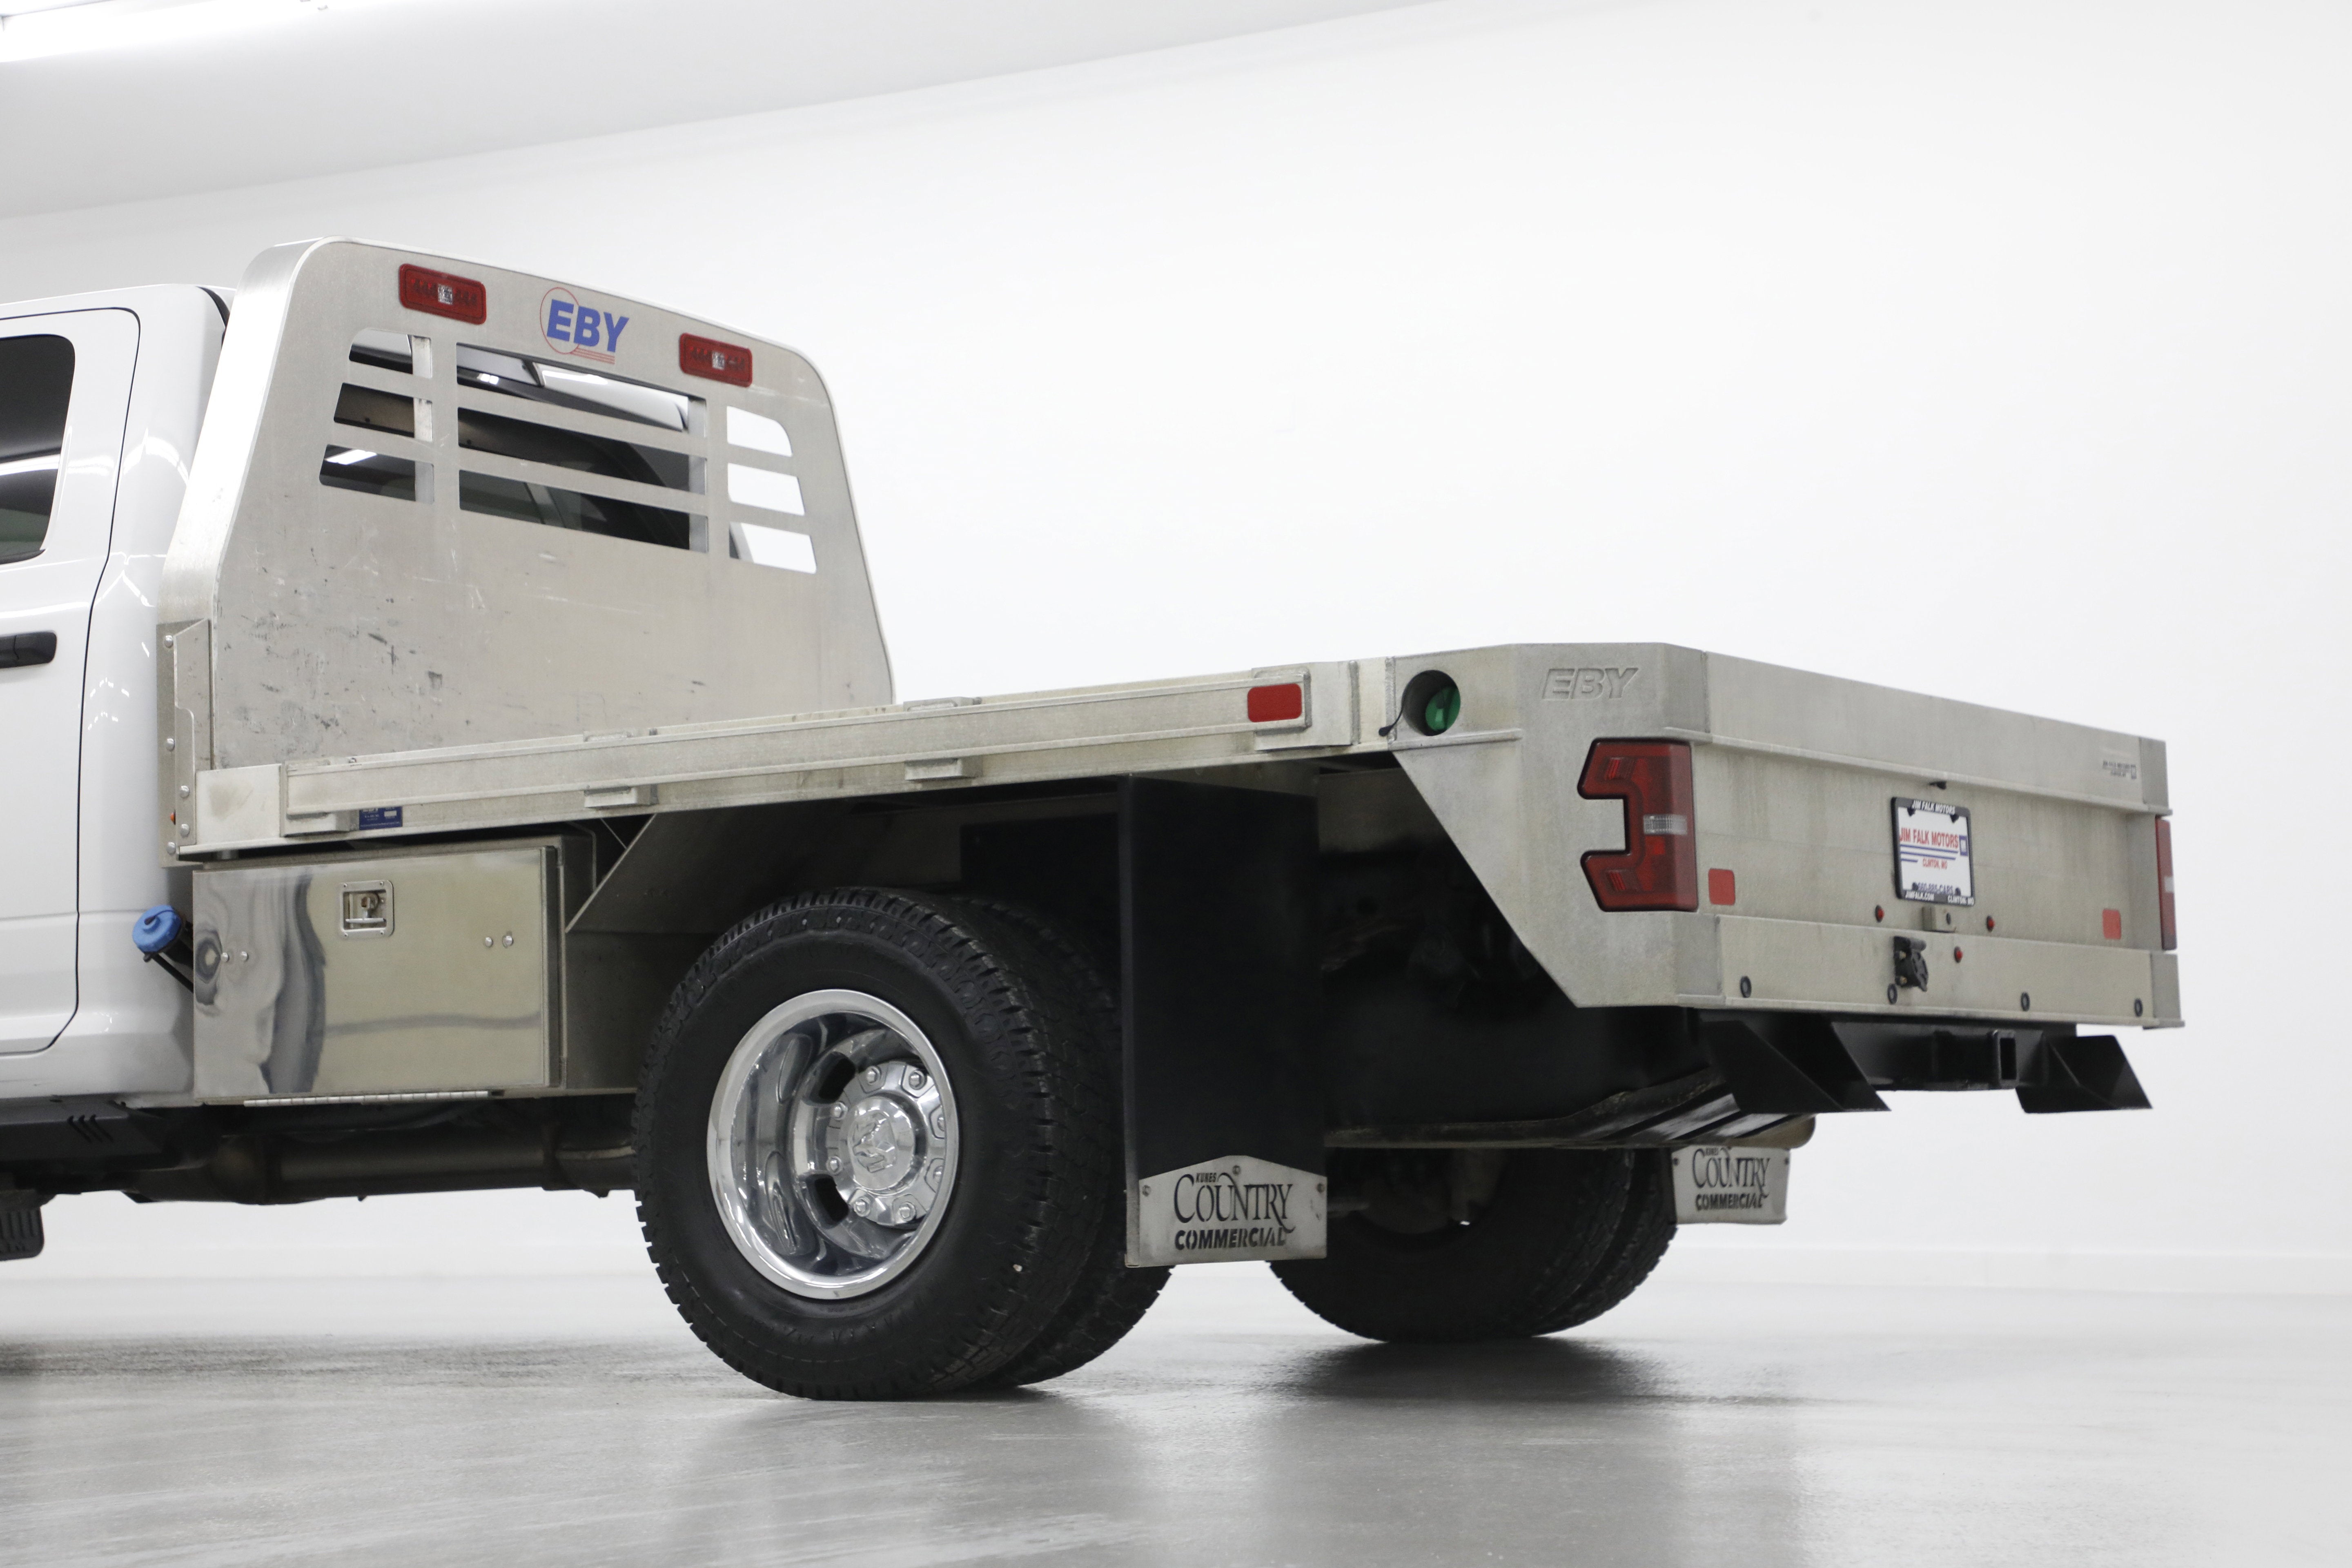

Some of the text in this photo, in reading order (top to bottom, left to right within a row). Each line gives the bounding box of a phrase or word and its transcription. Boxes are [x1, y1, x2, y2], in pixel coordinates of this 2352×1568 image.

[547, 299, 630, 352] EBY
[1542, 668, 1639, 700] EBY
[1912, 799, 1956, 815] JIM FALK MOTORS
[1899, 827, 1959, 849] JIM FALK MOTORS
[1196, 1173, 1217, 1183] KUNES
[1175, 1227, 1286, 1250] COMMERCIAL
